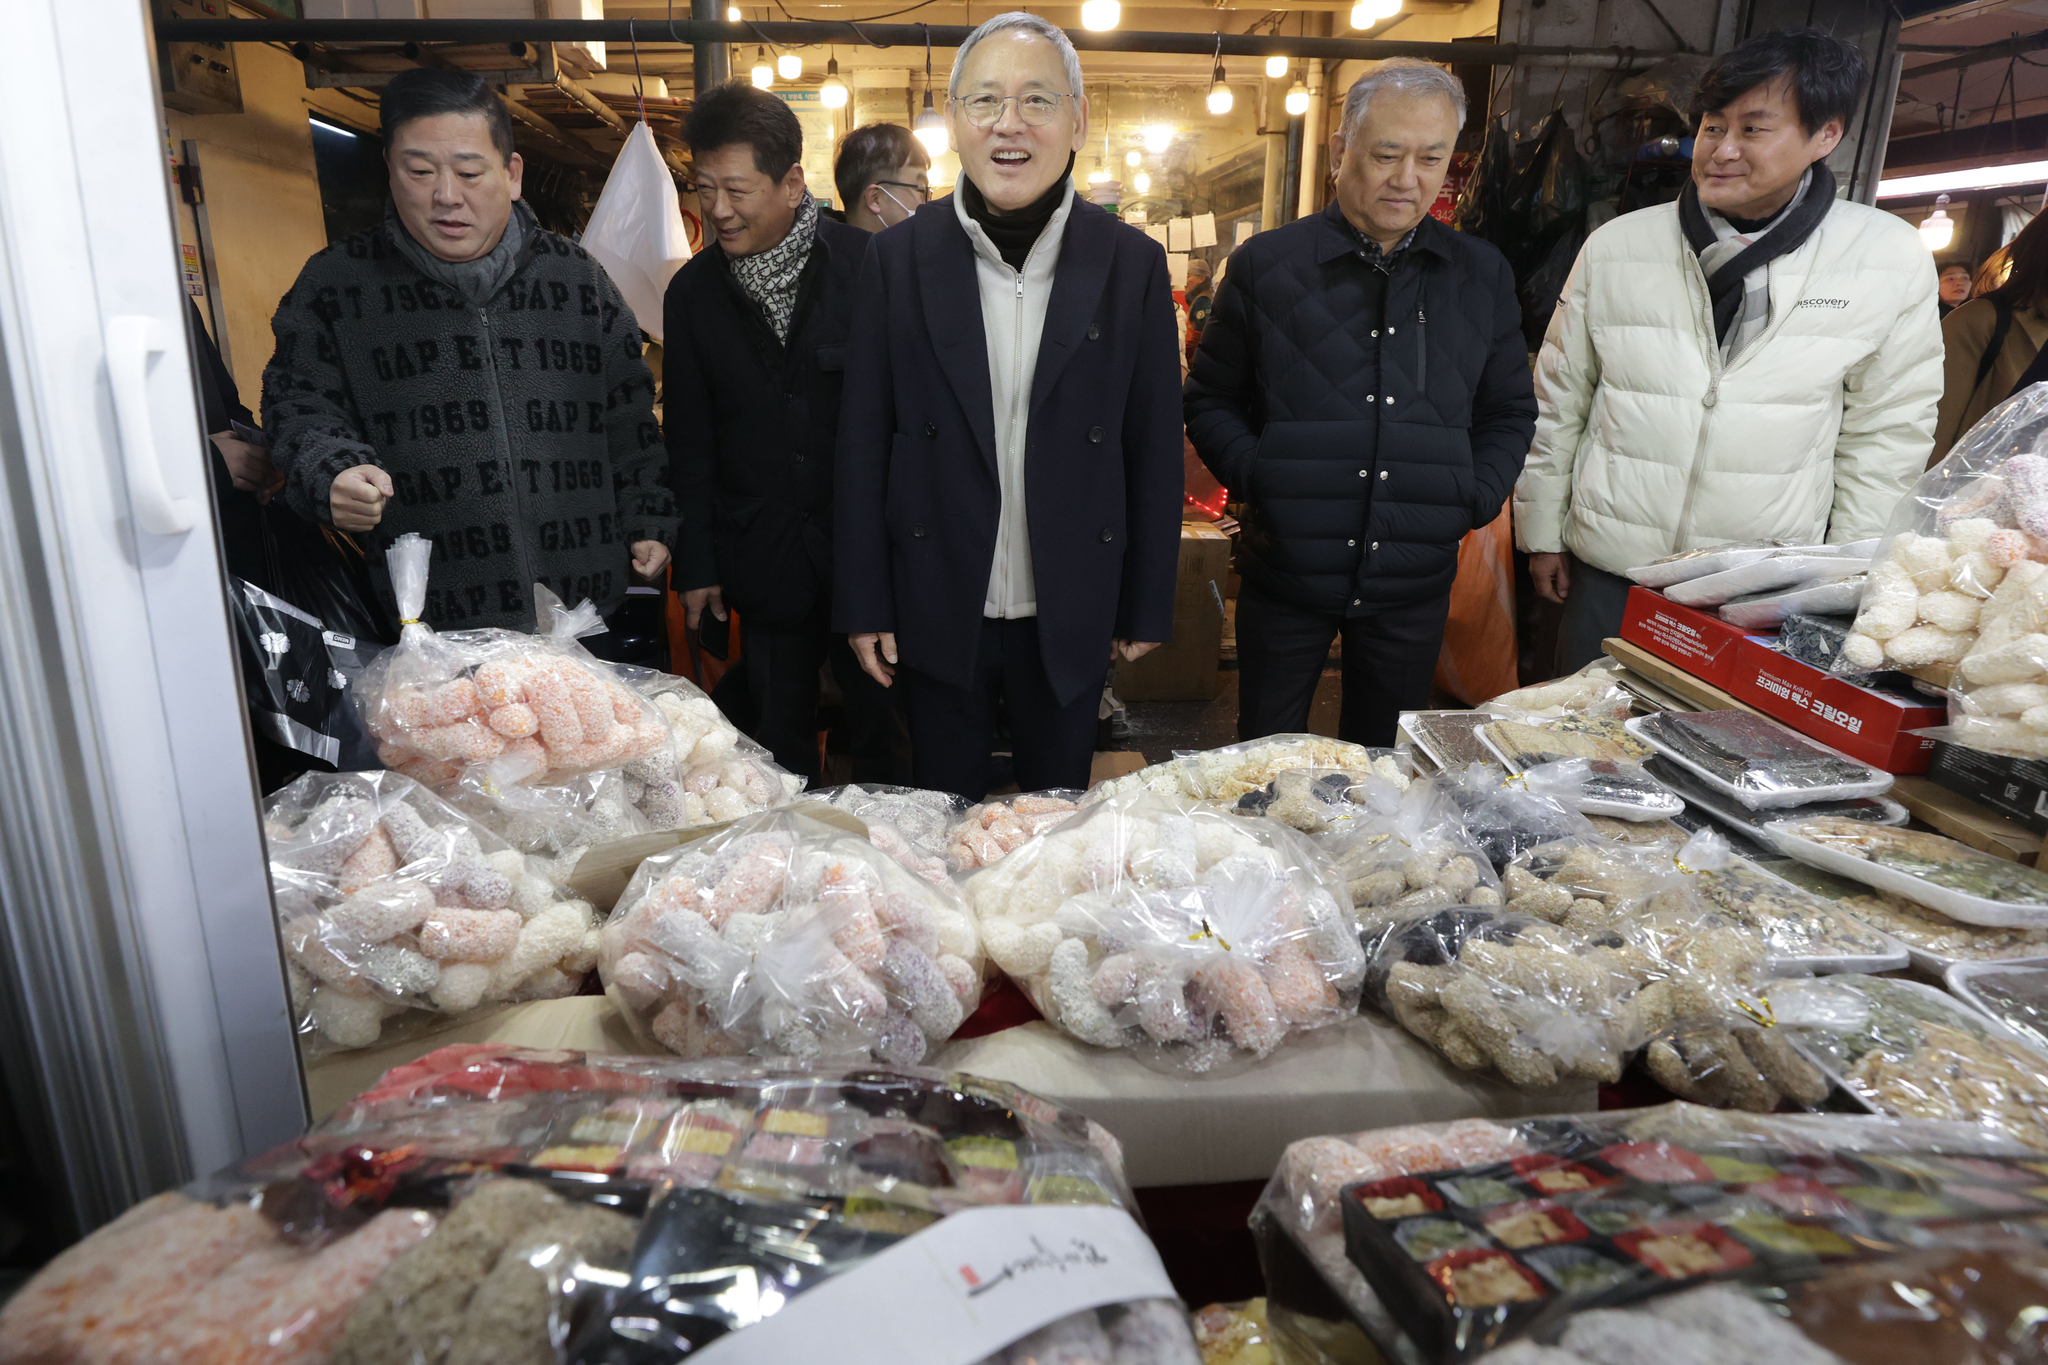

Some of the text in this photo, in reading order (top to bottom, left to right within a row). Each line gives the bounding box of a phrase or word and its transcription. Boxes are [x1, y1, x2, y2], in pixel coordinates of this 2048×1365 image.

[506, 278, 569, 312] GAP
[371, 338, 439, 382] GAP
[534, 337, 602, 376] 1969
[407, 399, 490, 442] 1969
[526, 398, 579, 434] GAP
[394, 465, 462, 507] GAP
[550, 459, 604, 494] 1969
[431, 521, 512, 562] 1969
[538, 517, 592, 552] GAP
[427, 583, 486, 623] GAP
[1755, 675, 1863, 735] 프리미엄 맥스 크릴오일
[1758, 668, 1813, 698] Premium Max Krill Oil
